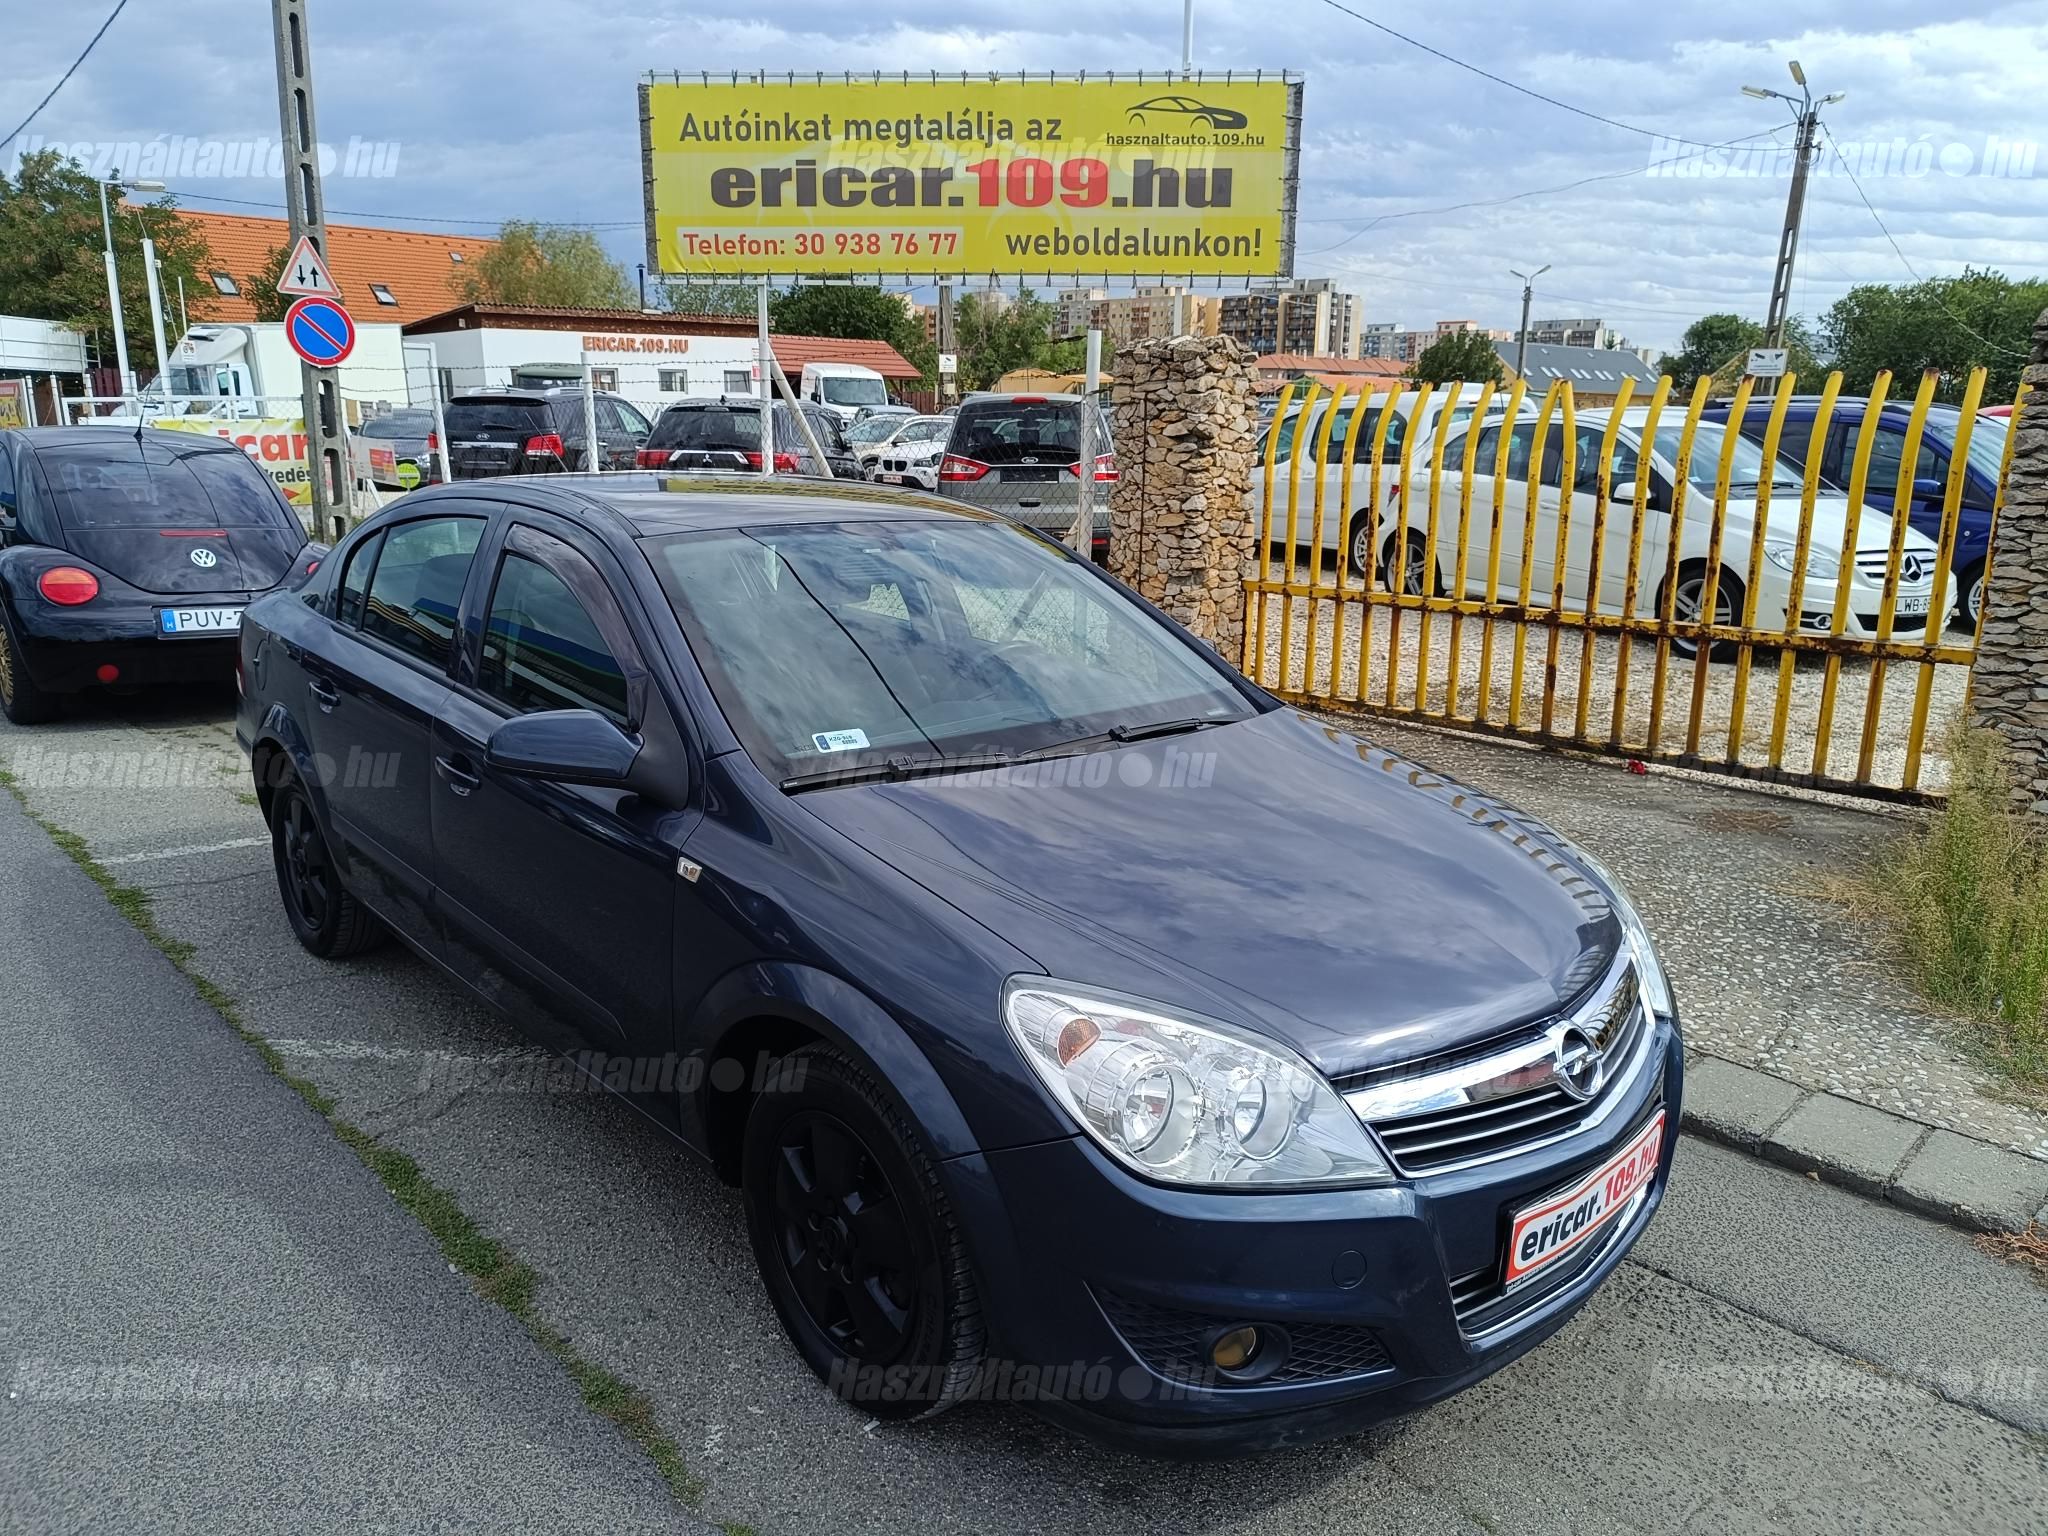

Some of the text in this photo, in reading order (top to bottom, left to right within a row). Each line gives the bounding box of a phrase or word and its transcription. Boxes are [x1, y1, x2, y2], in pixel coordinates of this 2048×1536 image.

[679, 107, 1062, 148] Autóinkat megtalálja az
[1106, 132, 1265, 146] hasznaltauto.109.hu
[711, 158, 1232, 209] ericar.109.hu
[683, 233, 957, 255] Telefon: 30 938 76 77
[1005, 227, 1261, 257] weboldalunkon!
[582, 335, 689, 354] ERICAR.109.HU
